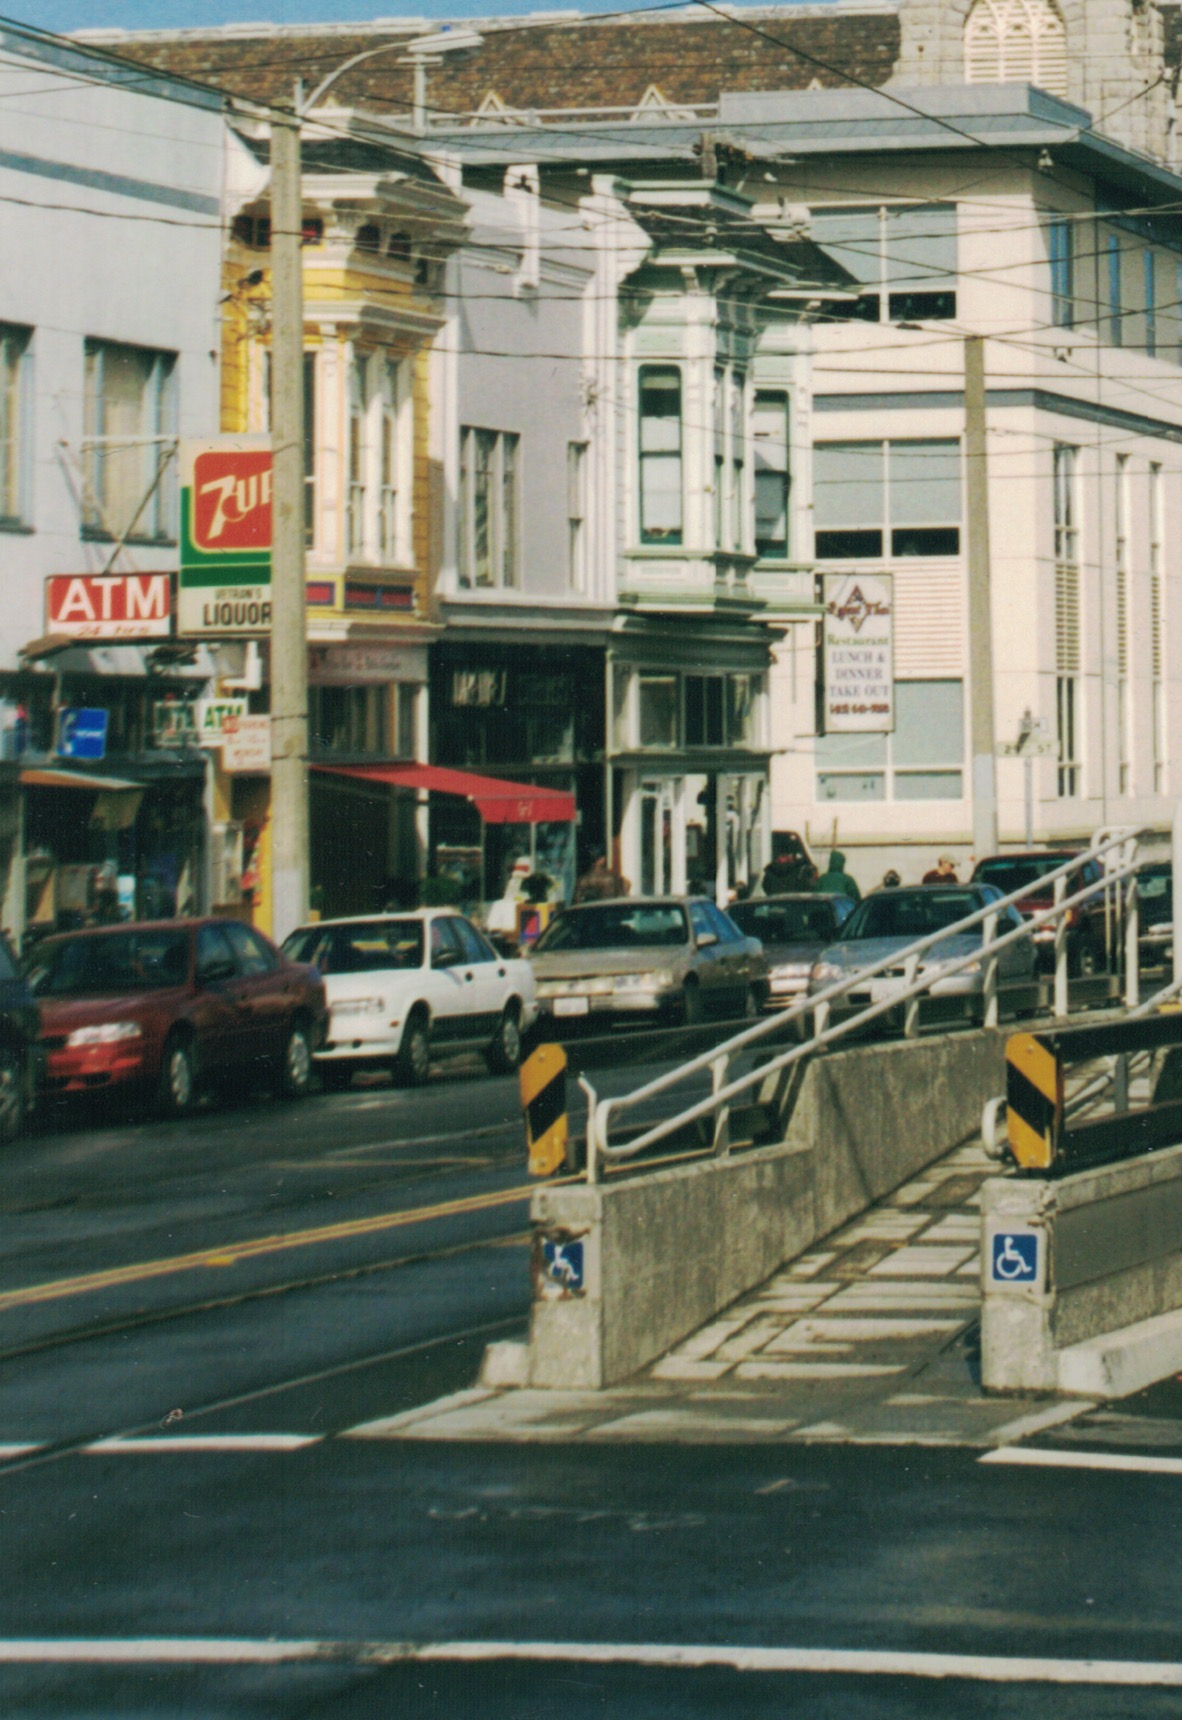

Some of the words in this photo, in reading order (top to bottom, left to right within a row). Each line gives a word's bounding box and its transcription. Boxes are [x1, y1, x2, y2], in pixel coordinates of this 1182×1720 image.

[57, 576, 165, 621] ATM
[832, 651, 873, 663] LUNCH
[835, 668, 883, 680] DINNER
[829, 685, 860, 697] TAKE
[864, 685, 889, 697] OUT
